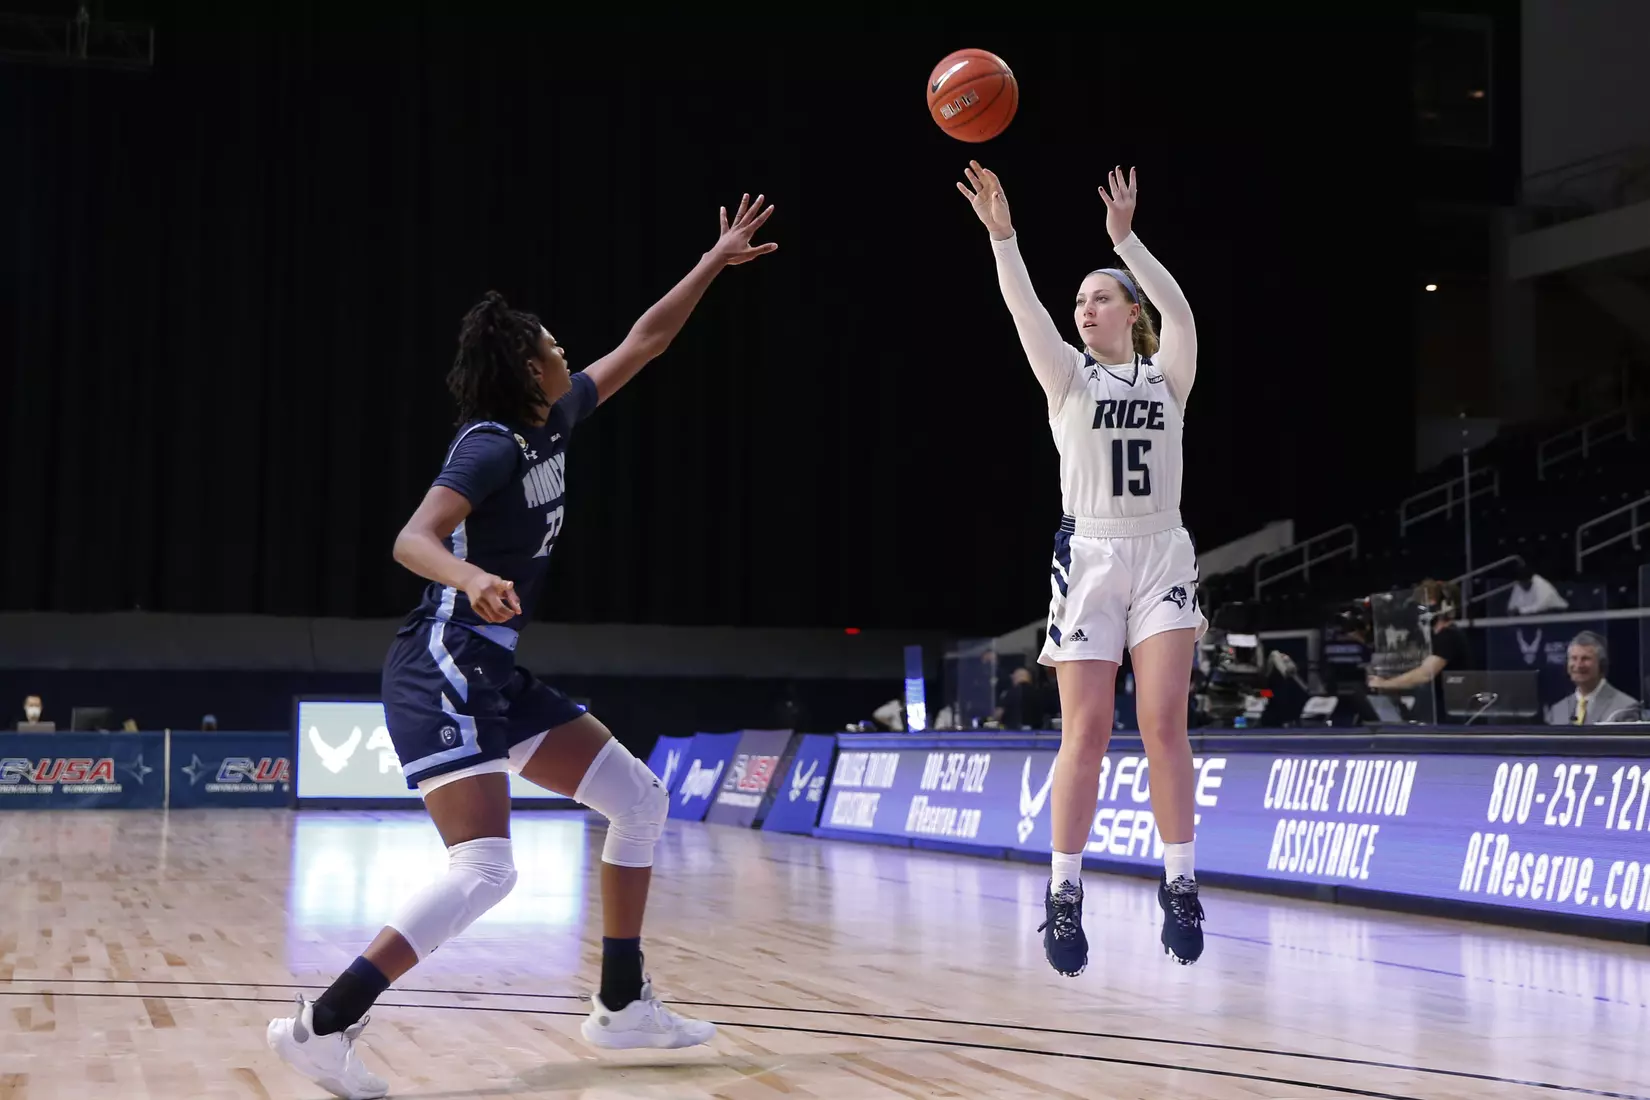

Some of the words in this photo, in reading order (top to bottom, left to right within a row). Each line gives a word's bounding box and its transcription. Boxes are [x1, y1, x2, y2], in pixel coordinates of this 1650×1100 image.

[1092, 399, 1165, 430] RICE
[1112, 439, 1152, 497] 15
[1109, 755, 1227, 807] FOE
[1263, 758, 1339, 812] COLLEGE
[1337, 759, 1418, 816] TUITION
[1487, 762, 1650, 832] 800-257-121
[1266, 818, 1380, 880] ASSISTANCE
